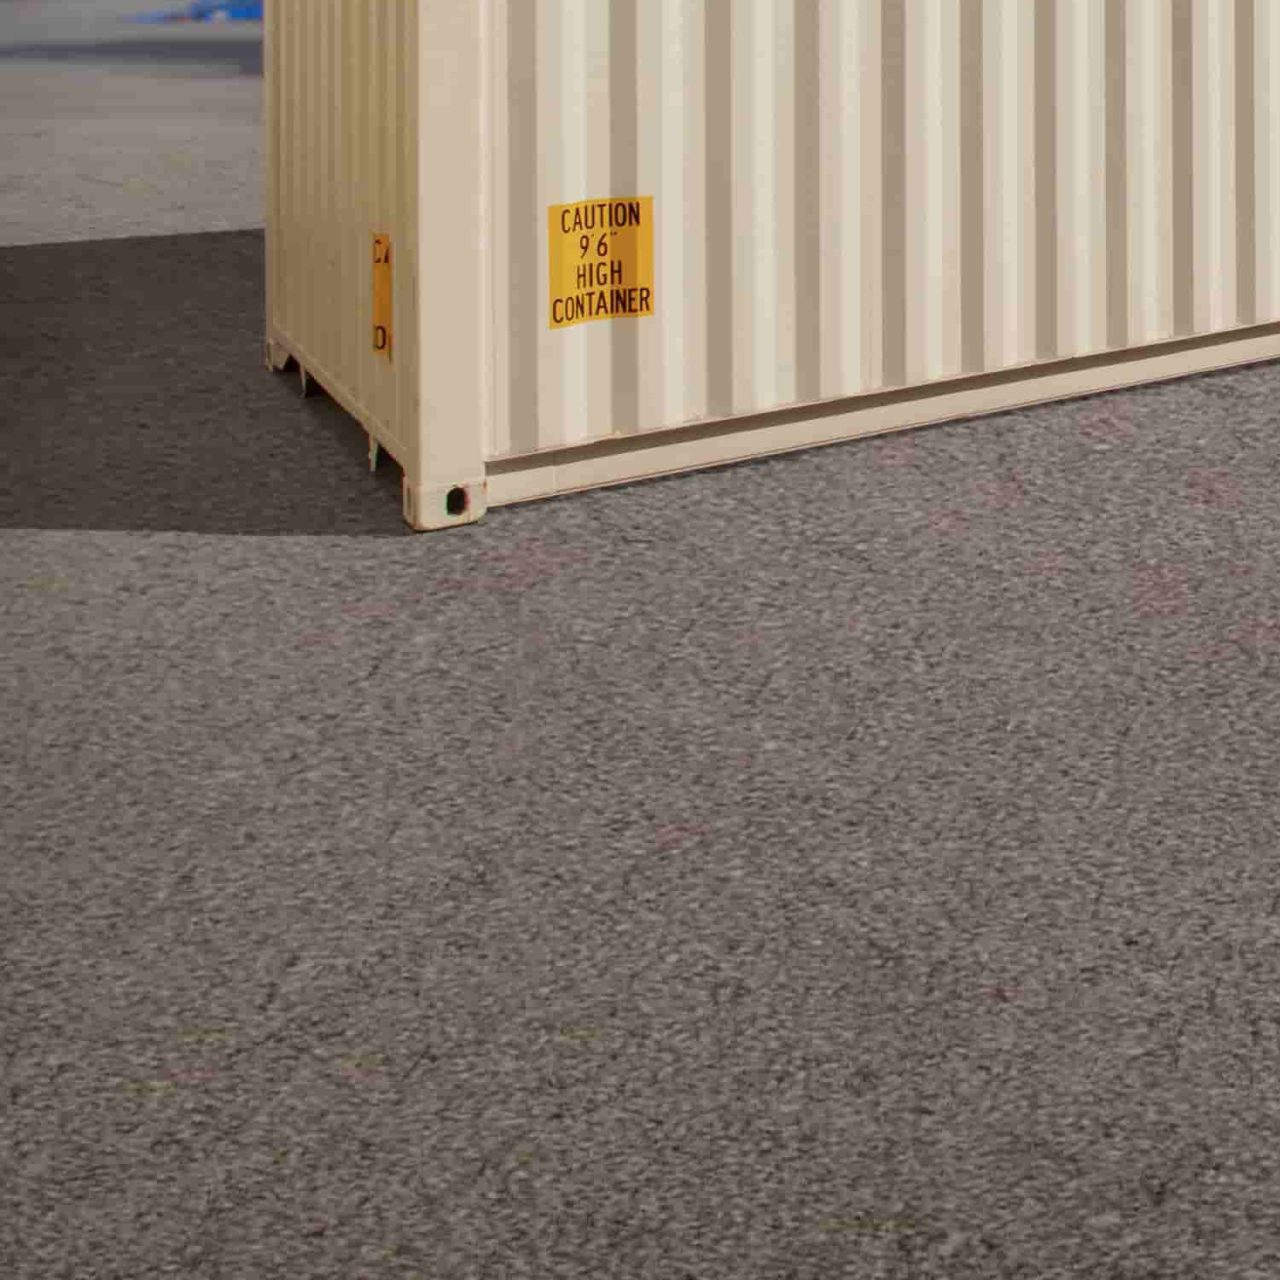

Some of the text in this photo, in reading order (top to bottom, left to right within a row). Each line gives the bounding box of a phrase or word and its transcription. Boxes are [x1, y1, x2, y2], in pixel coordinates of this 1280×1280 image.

[561, 201, 641, 233] CAUTION
[576, 259, 622, 290] HIGH
[552, 287, 651, 324] CONTAINER
